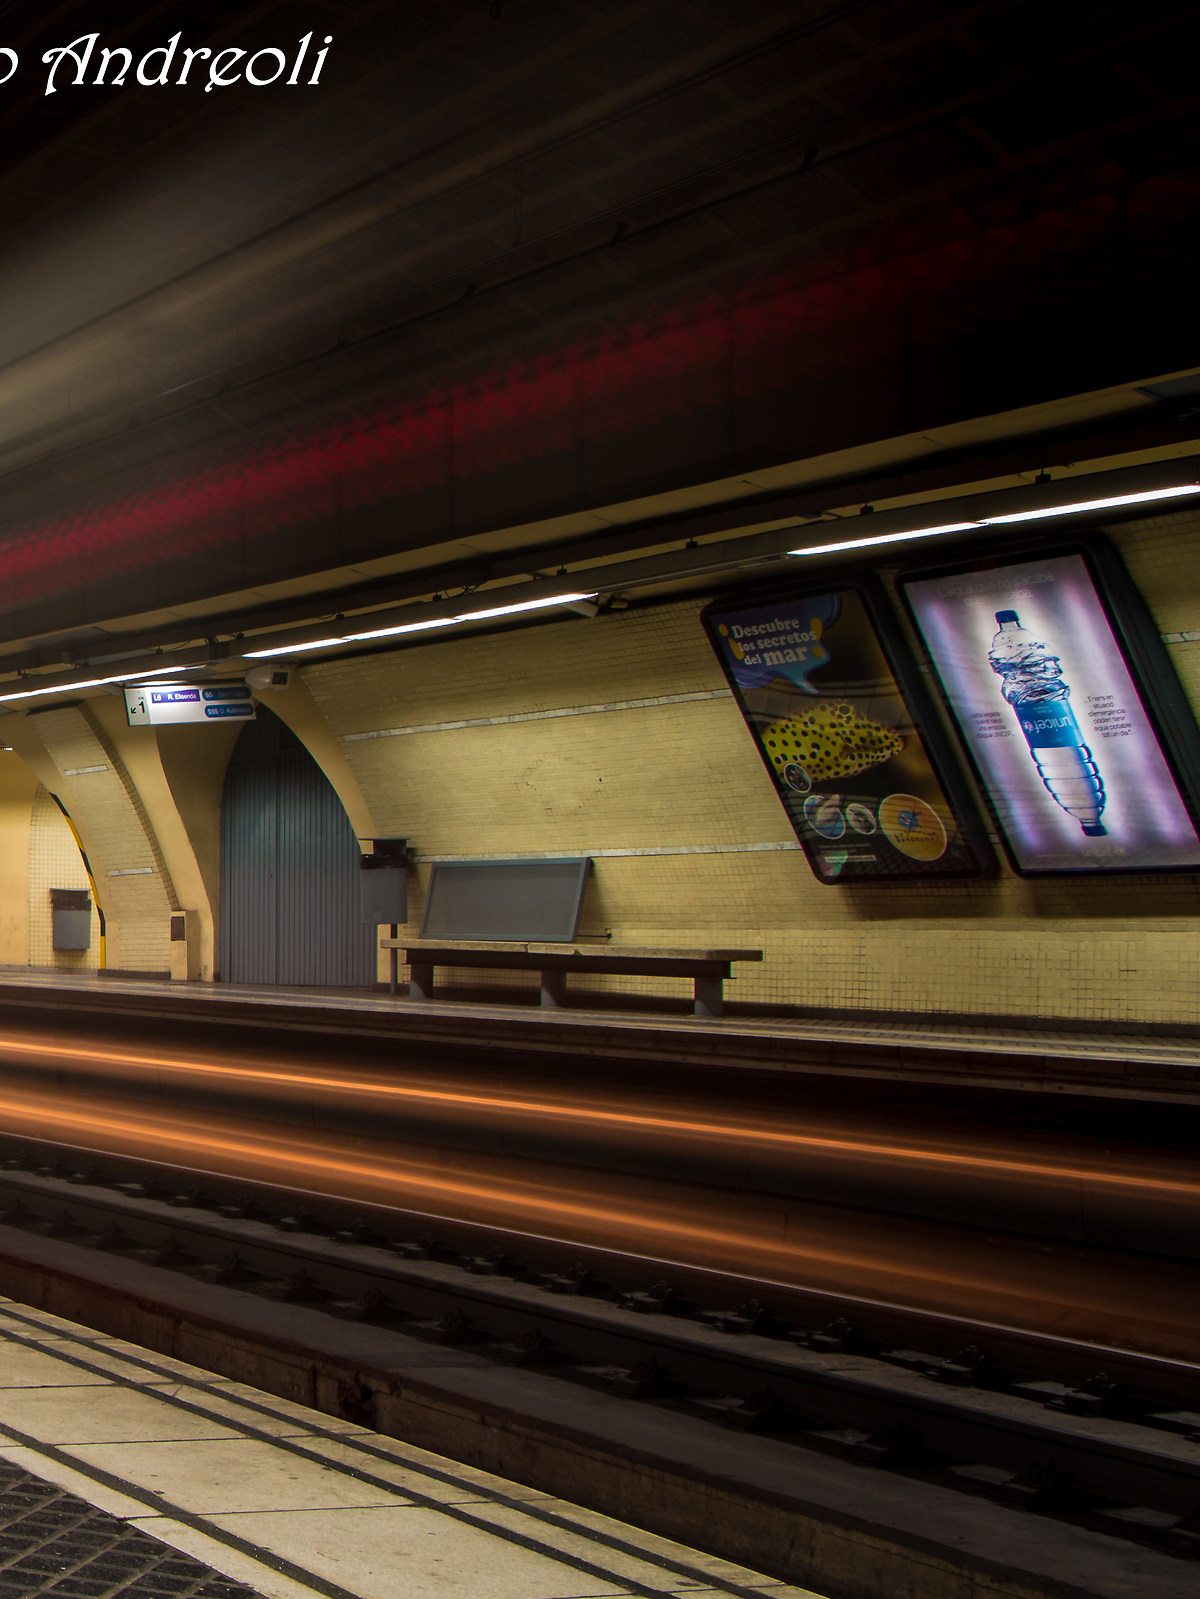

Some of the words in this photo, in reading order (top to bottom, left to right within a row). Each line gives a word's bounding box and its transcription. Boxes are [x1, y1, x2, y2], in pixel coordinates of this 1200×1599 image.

[731, 617, 800, 639] Descubre
[737, 641, 756, 652] los
[757, 630, 818, 649] secretos
[744, 653, 763, 666] del
[762, 646, 808, 666] mar
[138, 700, 146, 714] 1
[1033, 716, 1073, 734] unicef
